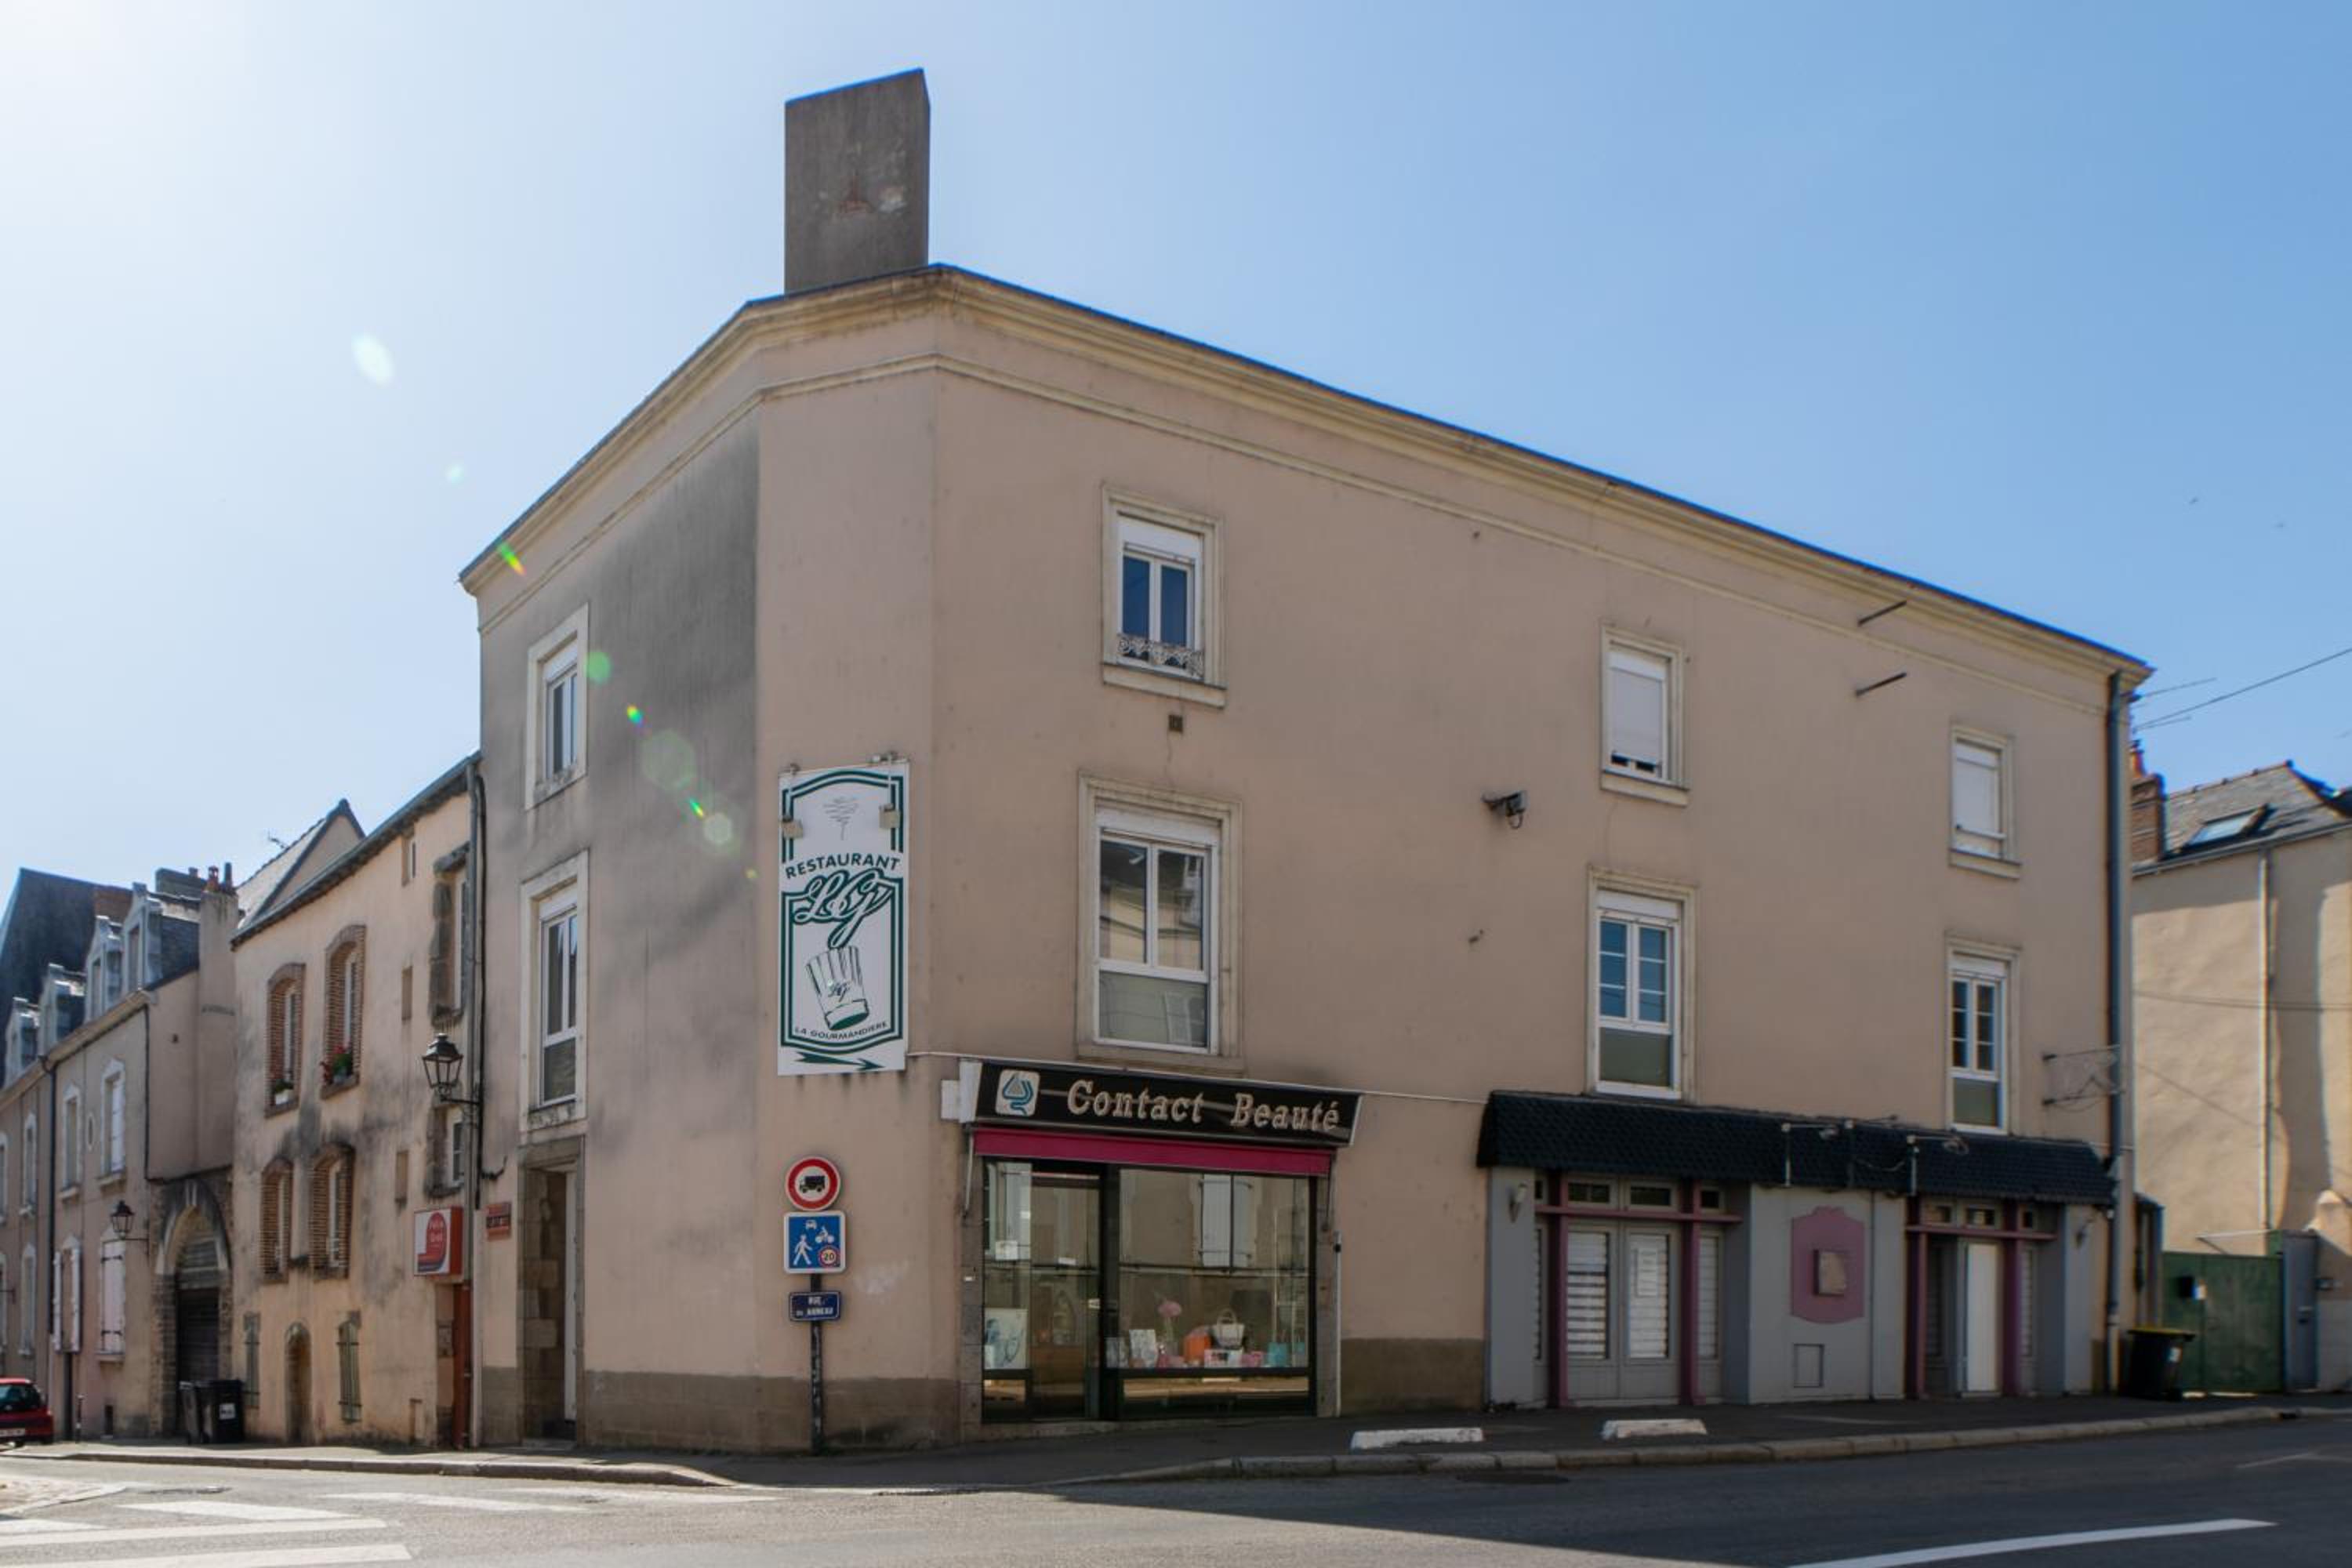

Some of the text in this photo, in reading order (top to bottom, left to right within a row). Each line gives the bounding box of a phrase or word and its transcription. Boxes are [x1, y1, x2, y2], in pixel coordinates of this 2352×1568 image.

[786, 852, 901, 879] RESTAURANT
[1067, 1080, 1340, 1131] Contact Beauté
